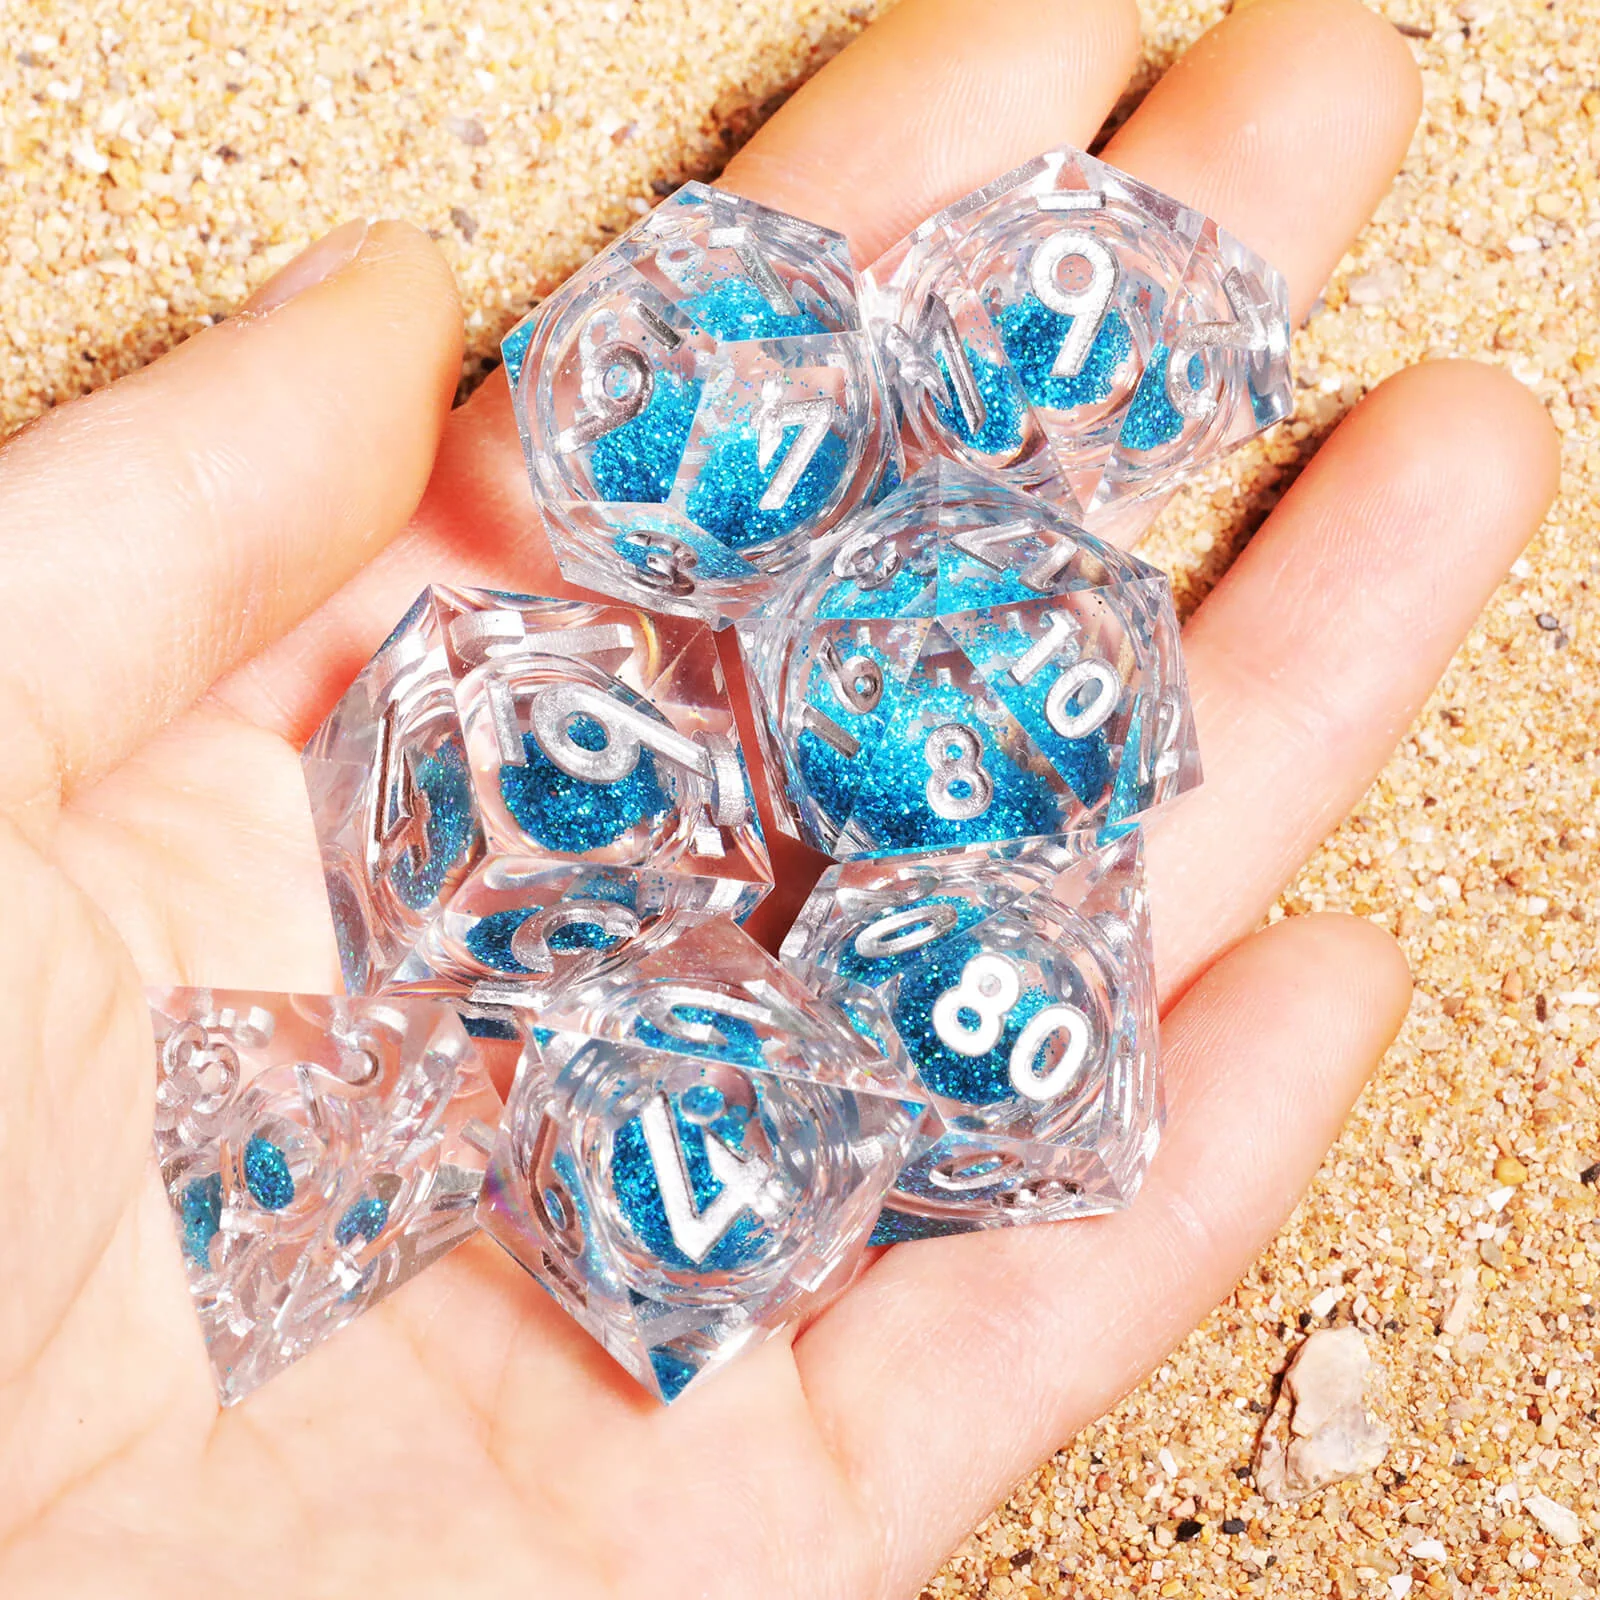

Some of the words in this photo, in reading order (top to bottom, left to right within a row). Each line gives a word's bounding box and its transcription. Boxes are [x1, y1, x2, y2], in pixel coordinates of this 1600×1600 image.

[708, 226, 801, 316] 7
[1006, 608, 1123, 740] 10
[925, 723, 994, 821] 8
[931, 950, 1093, 1101] 80
[641, 1089, 800, 1265] 4
